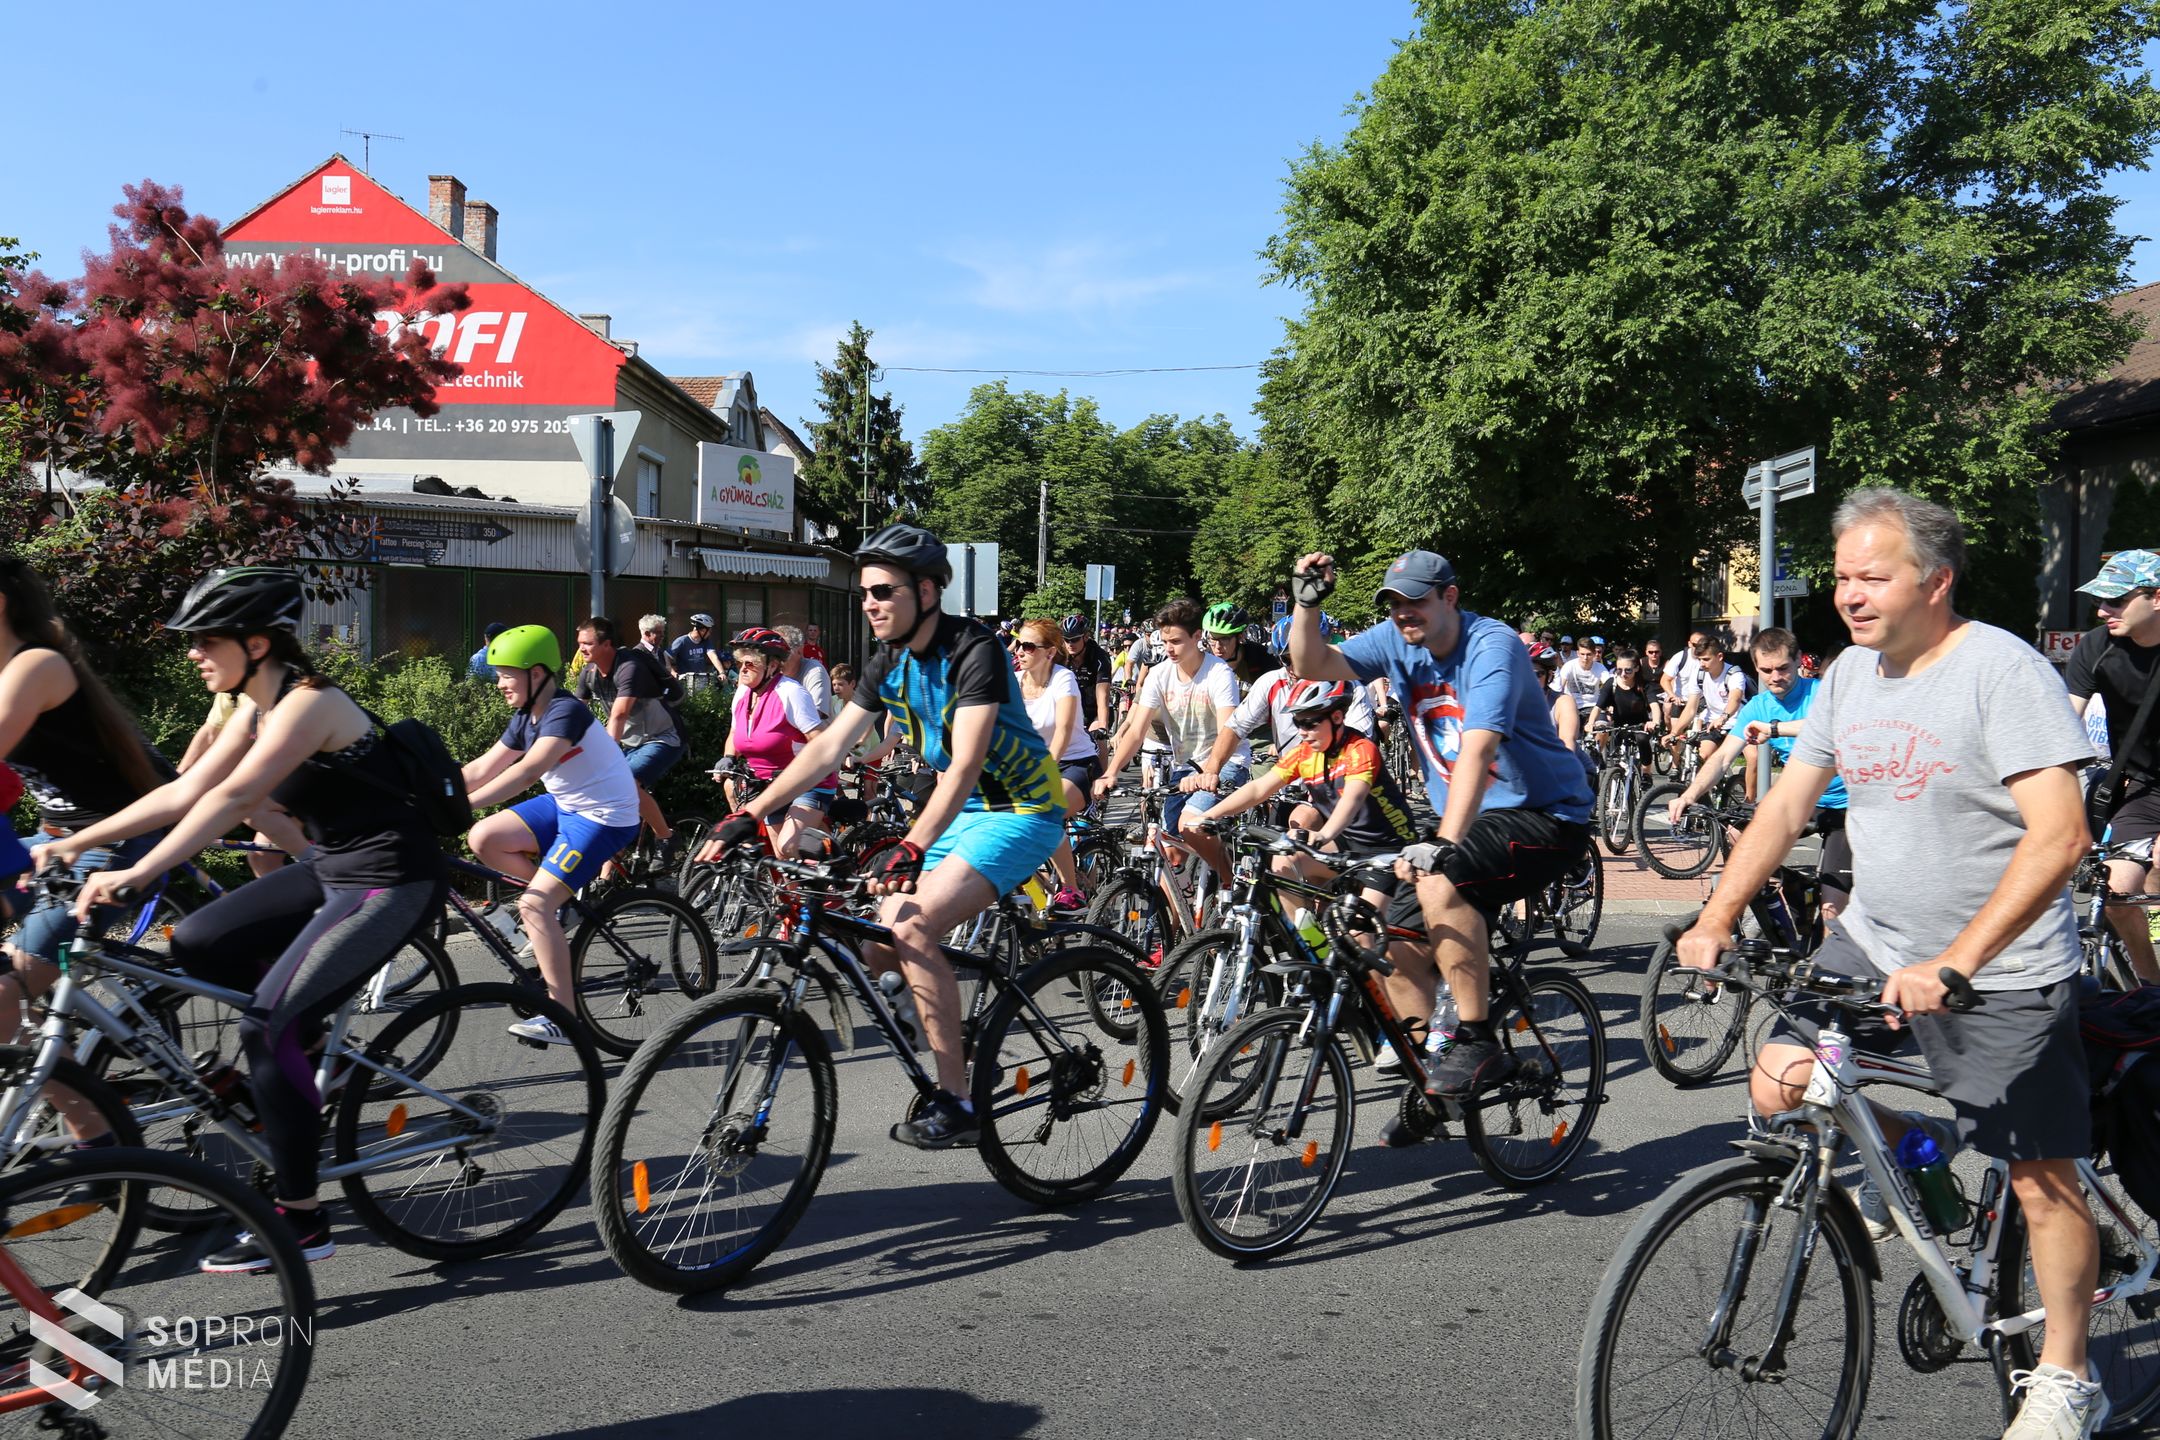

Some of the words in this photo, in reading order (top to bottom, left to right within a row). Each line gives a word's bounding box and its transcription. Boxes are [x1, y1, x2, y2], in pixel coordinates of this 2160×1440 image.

[372, 310, 528, 363] ROFI
[414, 419, 451, 431] TEL.:
[454, 418, 484, 433] +36
[488, 419, 507, 433] 20
[511, 419, 539, 433] 975
[543, 420, 570, 434] 203
[711, 485, 718, 502] A
[548, 842, 584, 873] 10
